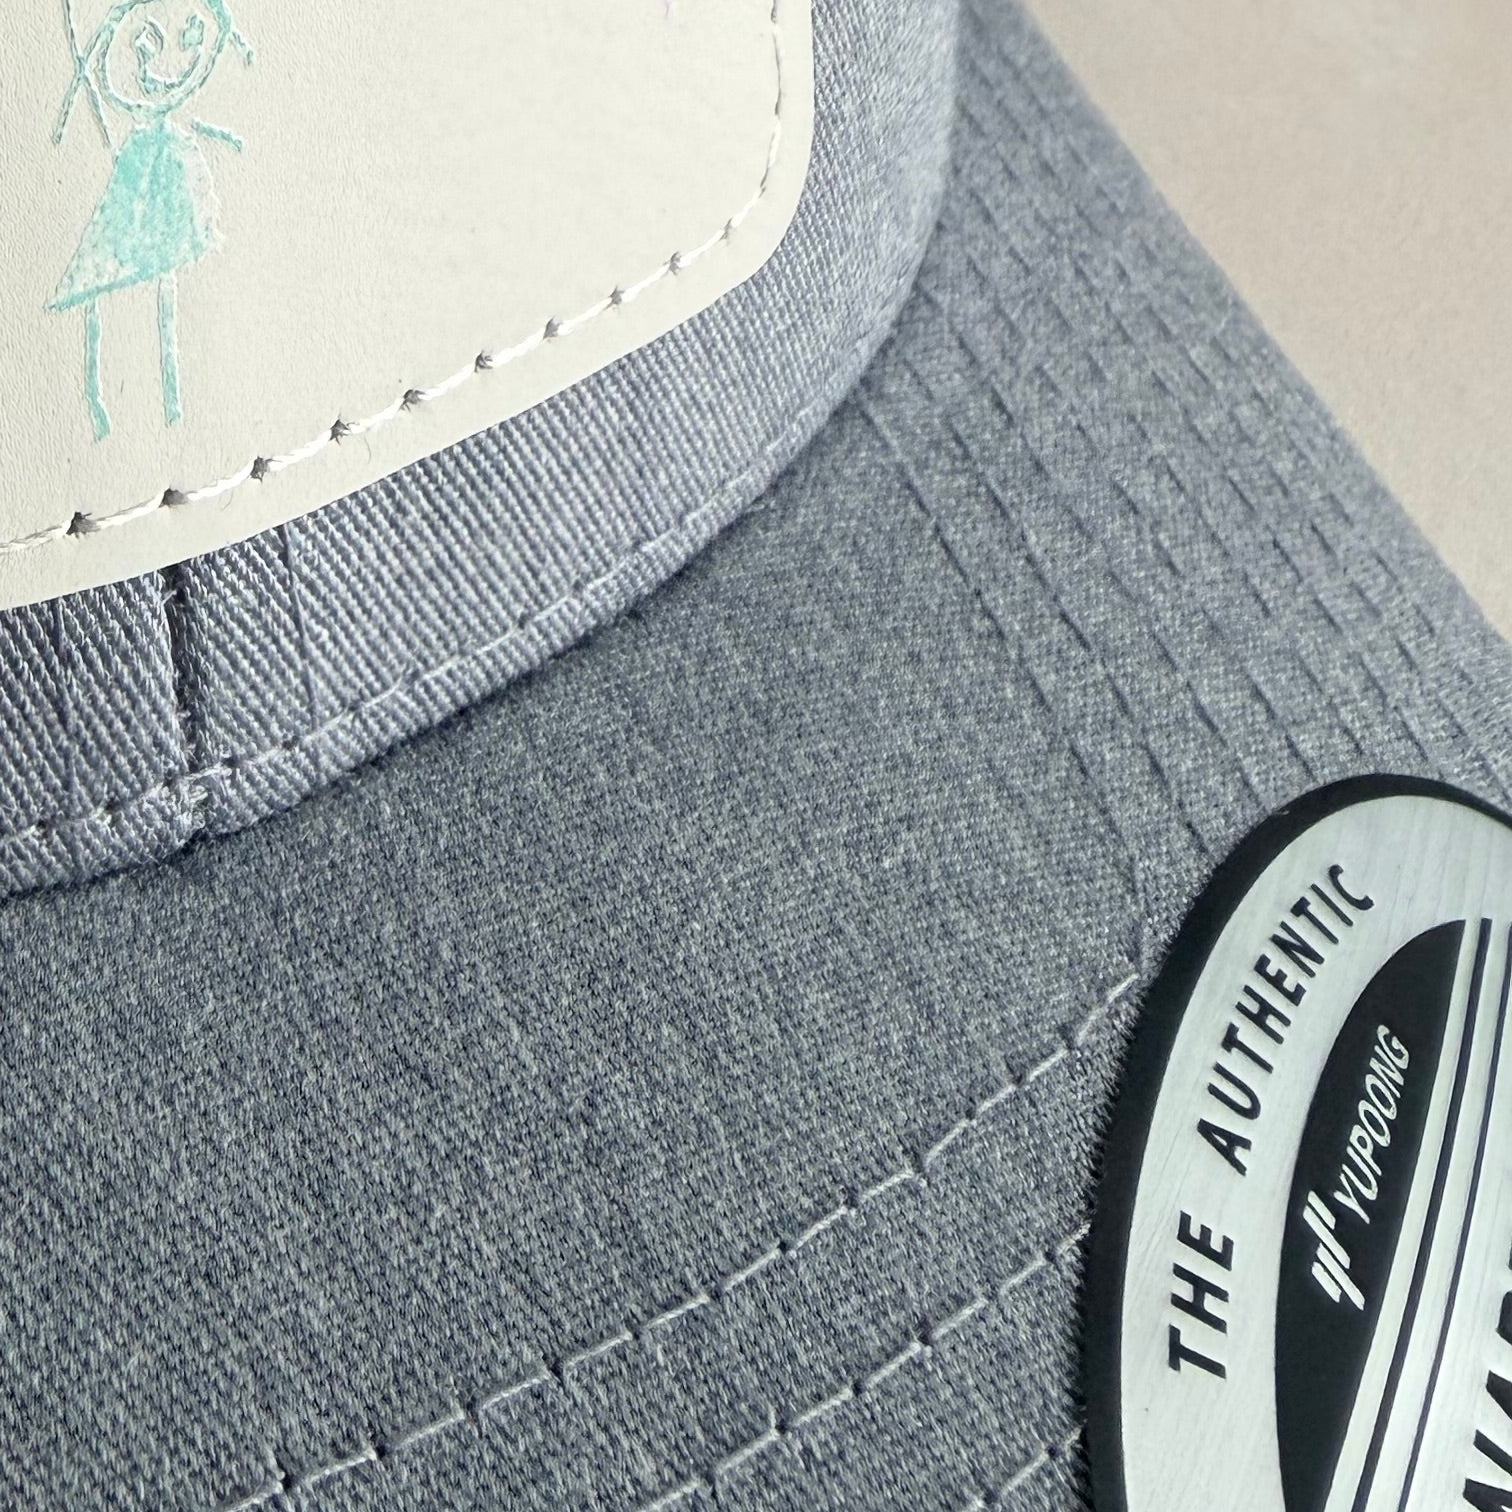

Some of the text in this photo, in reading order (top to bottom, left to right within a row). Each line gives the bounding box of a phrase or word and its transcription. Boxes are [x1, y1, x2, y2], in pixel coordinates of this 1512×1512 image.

[1167, 863, 1375, 1379] THE AUTHENTIC
[1333, 1024, 1410, 1224] YUPOONG
